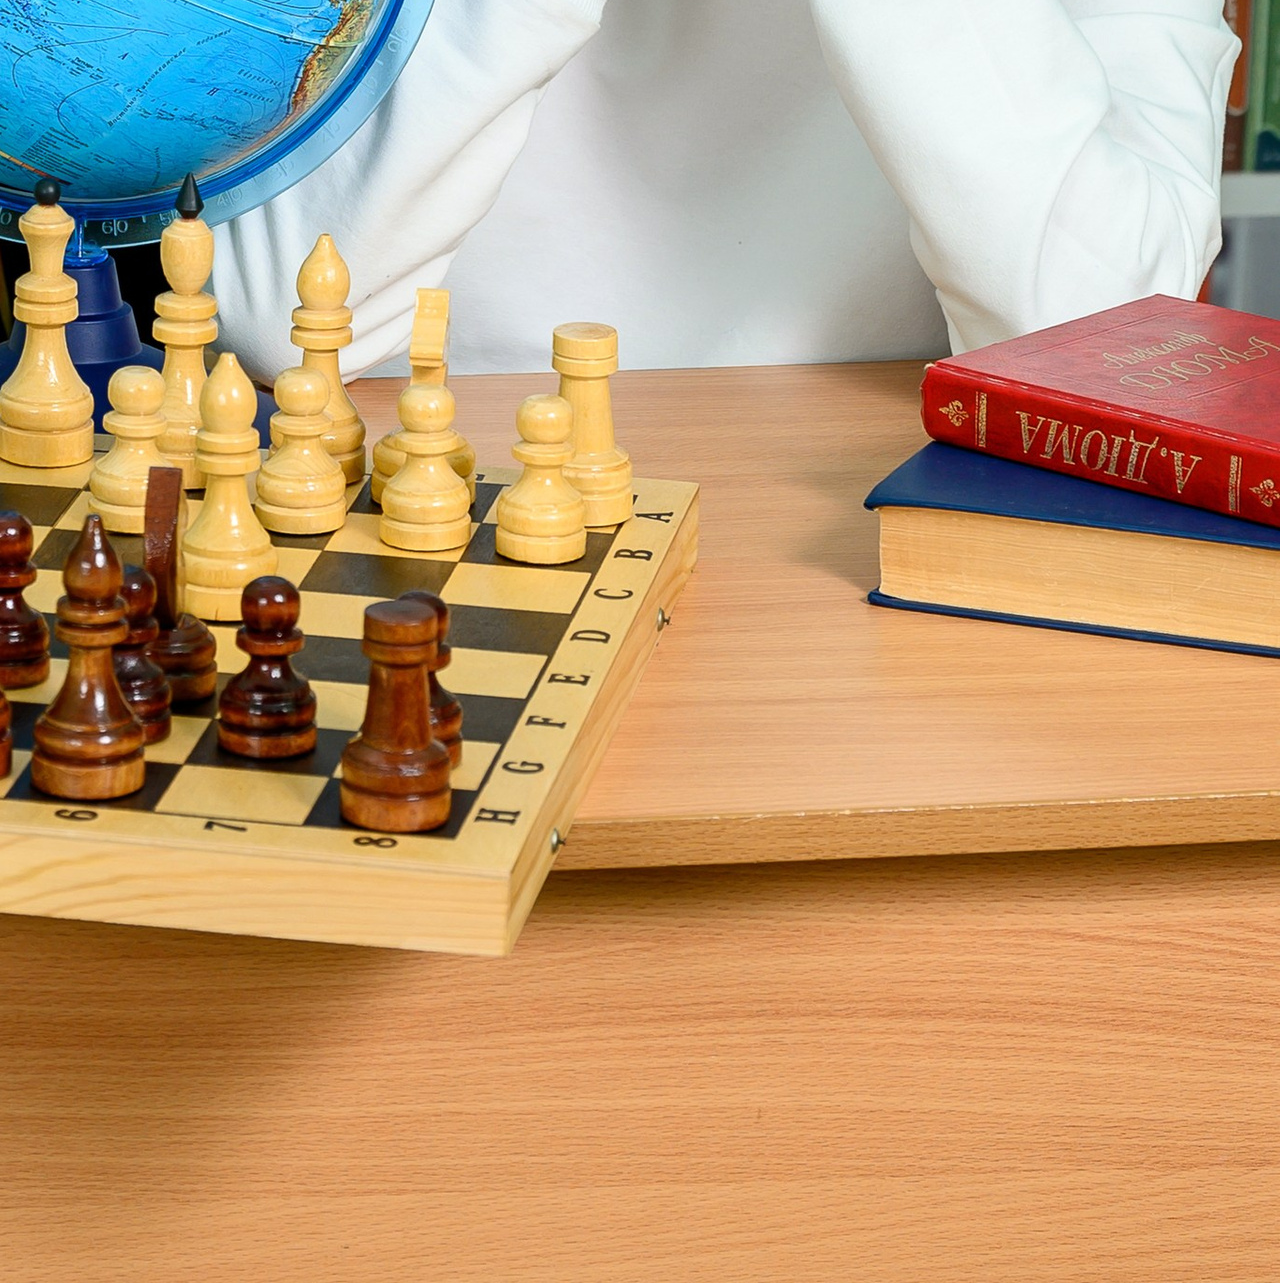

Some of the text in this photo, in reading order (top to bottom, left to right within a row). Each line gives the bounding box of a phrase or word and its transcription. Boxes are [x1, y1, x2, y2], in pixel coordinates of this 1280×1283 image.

[635, 511, 674, 524] A
[614, 548, 654, 561] B
[593, 587, 633, 600] C
[570, 629, 611, 644] D
[548, 672, 592, 687] E
[525, 715, 567, 729] F
[502, 760, 545, 775] G
[53, 807, 98, 822] 6
[474, 807, 521, 826] H
[202, 819, 247, 834] 7
[353, 835, 398, 849] 8
